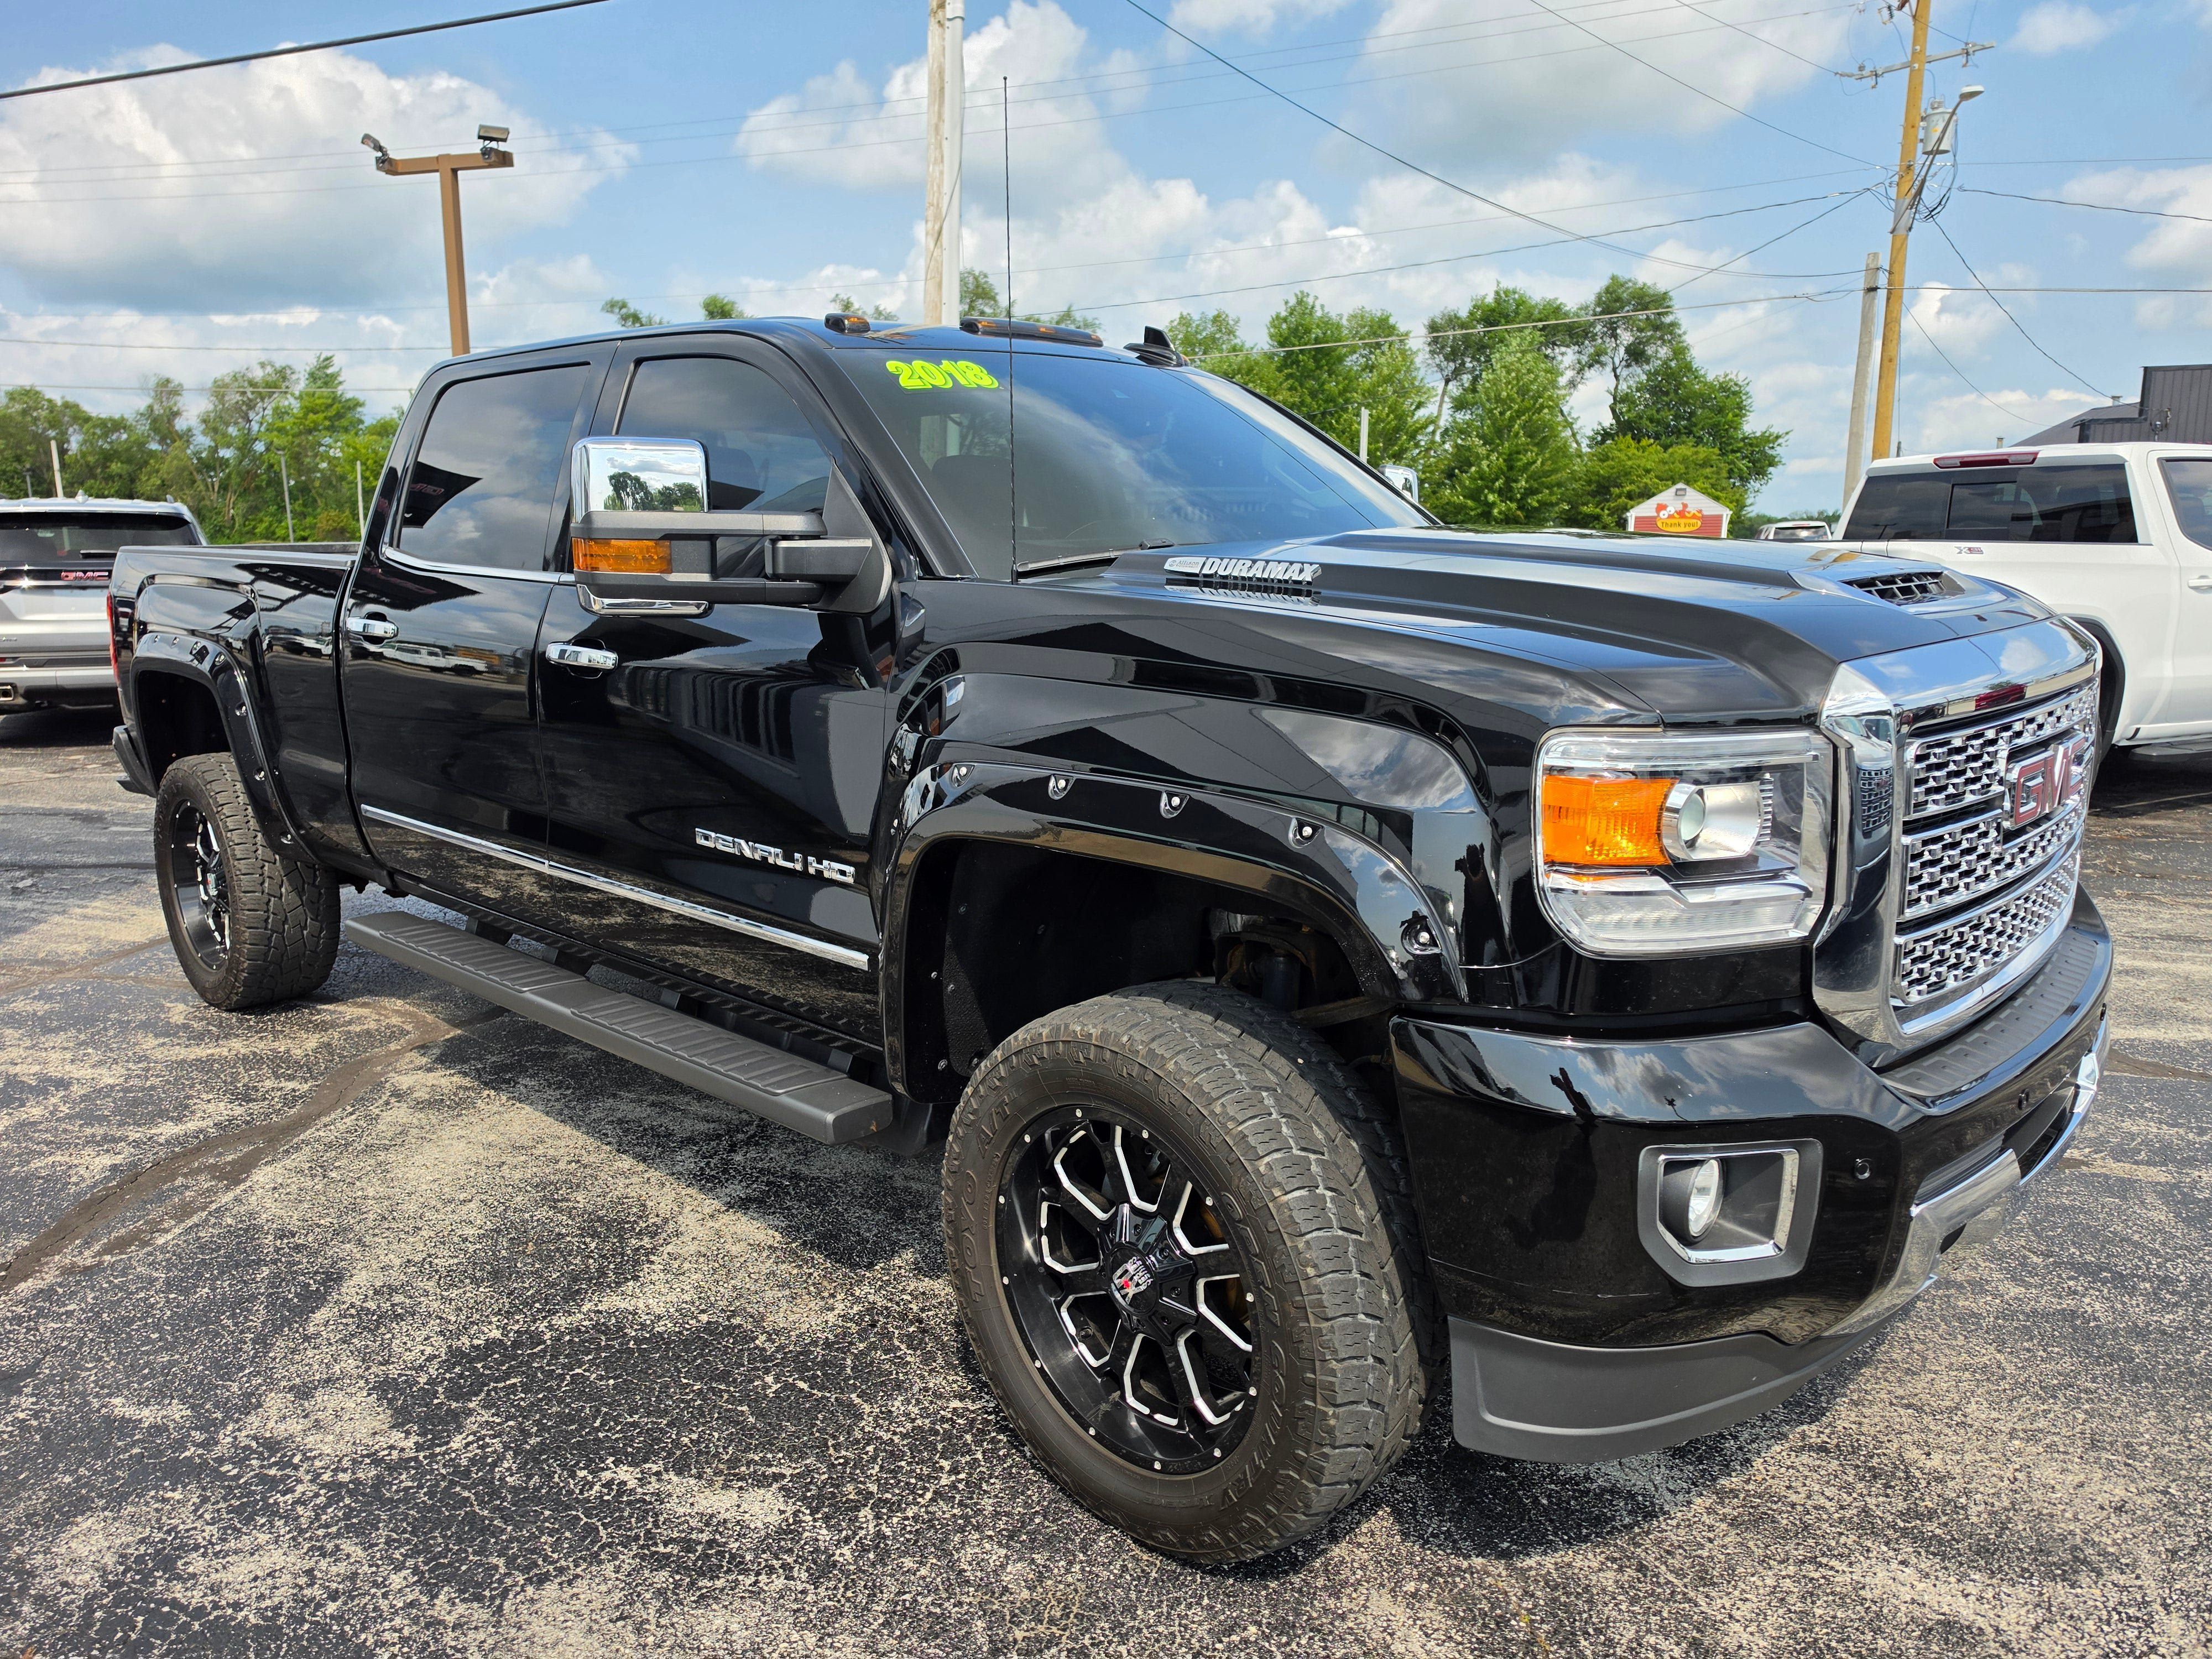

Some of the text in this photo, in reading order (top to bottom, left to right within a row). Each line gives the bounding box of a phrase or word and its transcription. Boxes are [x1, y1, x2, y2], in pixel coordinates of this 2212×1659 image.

[886, 360, 999, 389] 2018
[61, 571, 109, 581] GMC
[1201, 557, 1321, 583] DURAMAX
[2012, 733, 2086, 827] GMC
[695, 828, 855, 884] DENALI HD
[961, 1170, 985, 1302] TOYO
[1220, 1192, 1281, 1327] OPEN
[1219, 1340, 1286, 1511] COUNTRY
